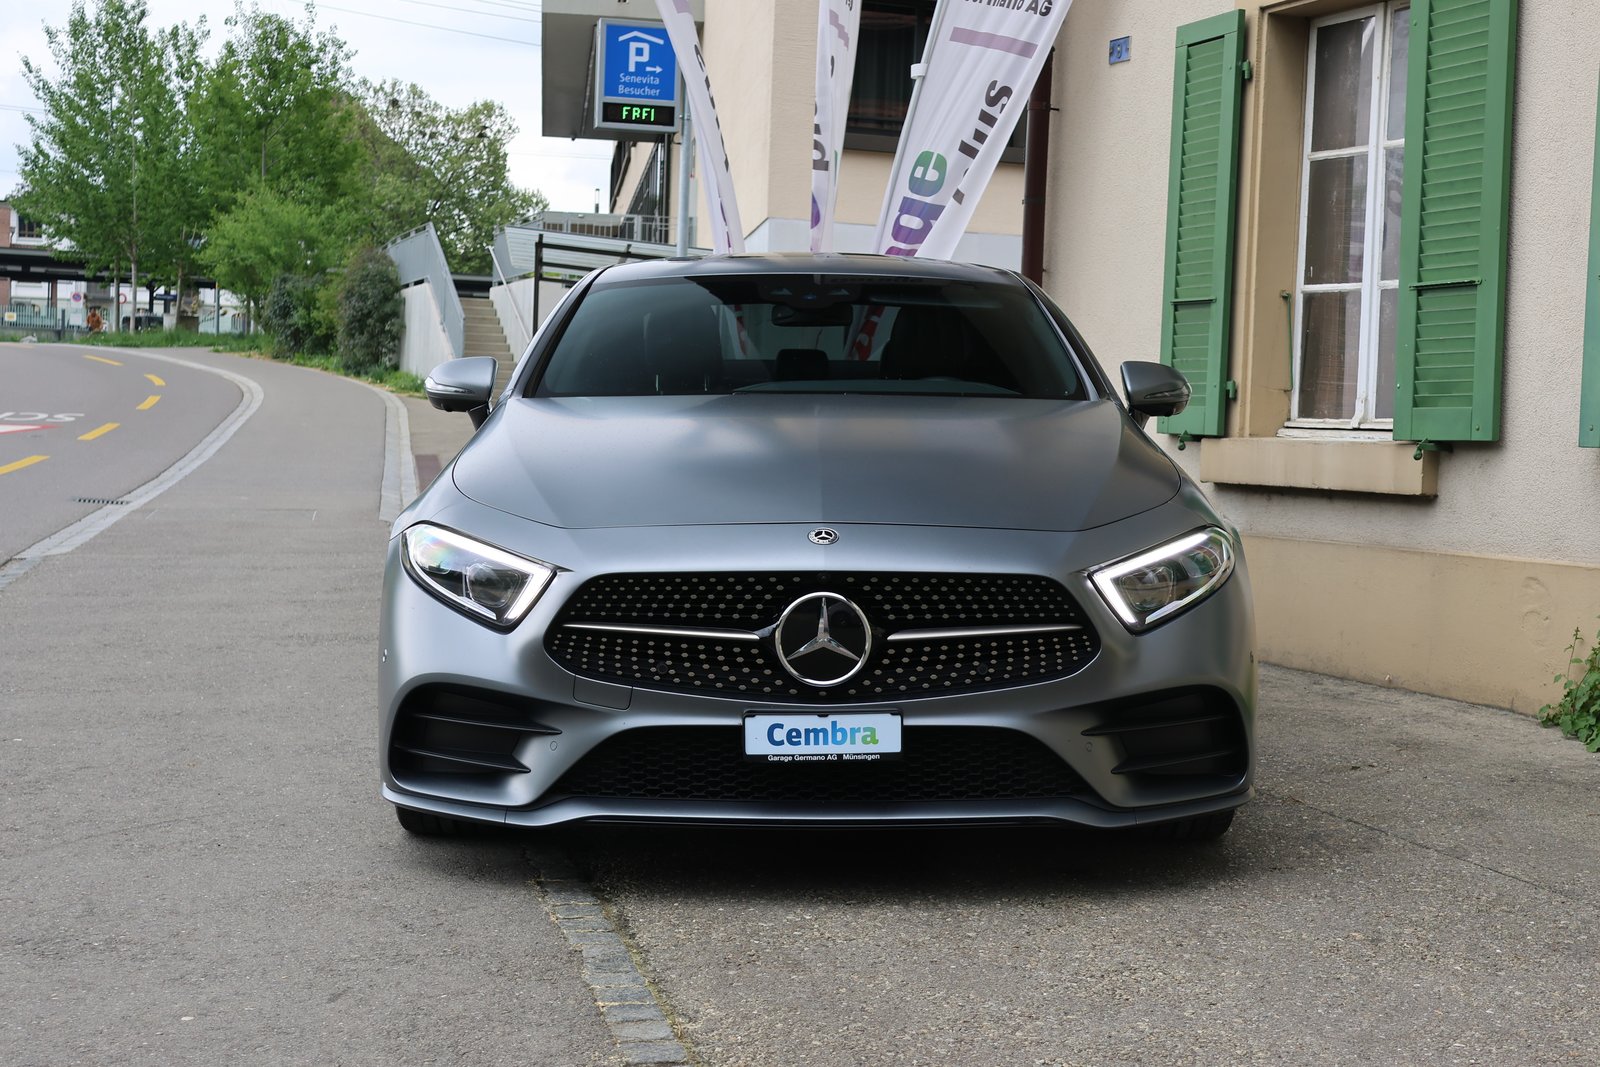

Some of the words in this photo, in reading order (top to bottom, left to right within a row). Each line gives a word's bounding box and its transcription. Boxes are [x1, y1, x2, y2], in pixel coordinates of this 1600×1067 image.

[1024, 0, 1053, 17] AG
[628, 41, 650, 72] P
[619, 72, 660, 85] Senevita
[618, 84, 660, 96] Besucher
[767, 721, 879, 746] Cembra
[768, 755, 793, 763] Garage
[843, 753, 880, 761] Münsingen
